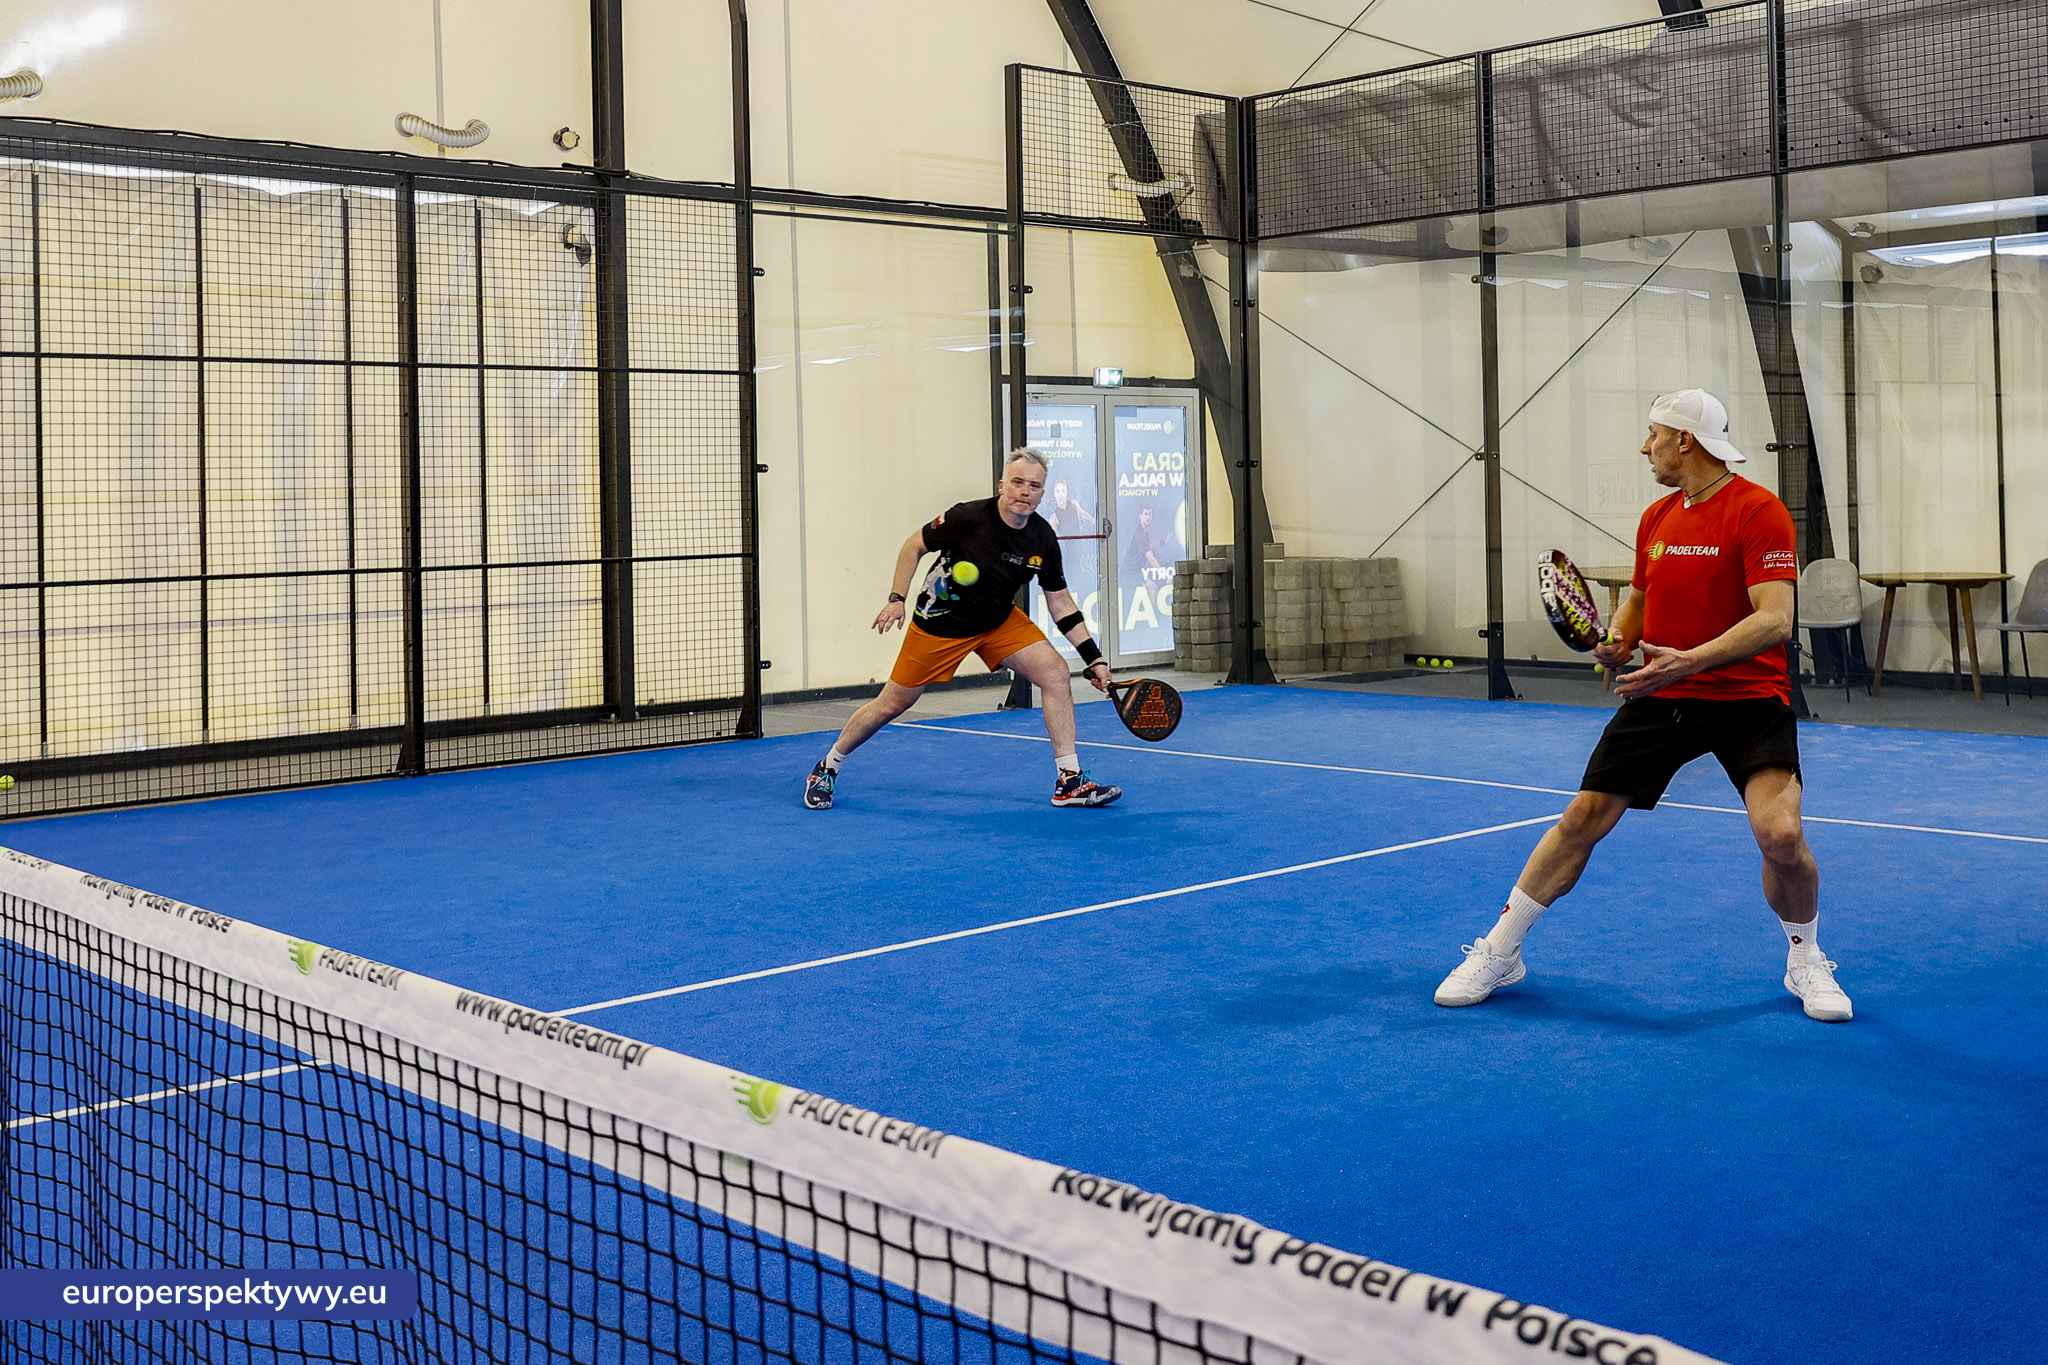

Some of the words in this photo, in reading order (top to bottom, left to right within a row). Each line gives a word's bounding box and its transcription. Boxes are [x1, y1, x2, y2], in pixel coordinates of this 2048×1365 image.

[1665, 545, 1720, 557] PADELTEAM
[319, 947, 406, 992] PADELTEAM
[455, 991, 653, 1071] www.padelteam.pl
[788, 1090, 948, 1159] PADELTEAM
[1052, 1168, 1260, 1265] Rozwijamy
[1271, 1237, 1412, 1302] Padel
[1426, 1283, 1470, 1318] w
[1484, 1296, 1658, 1365] Polsce
